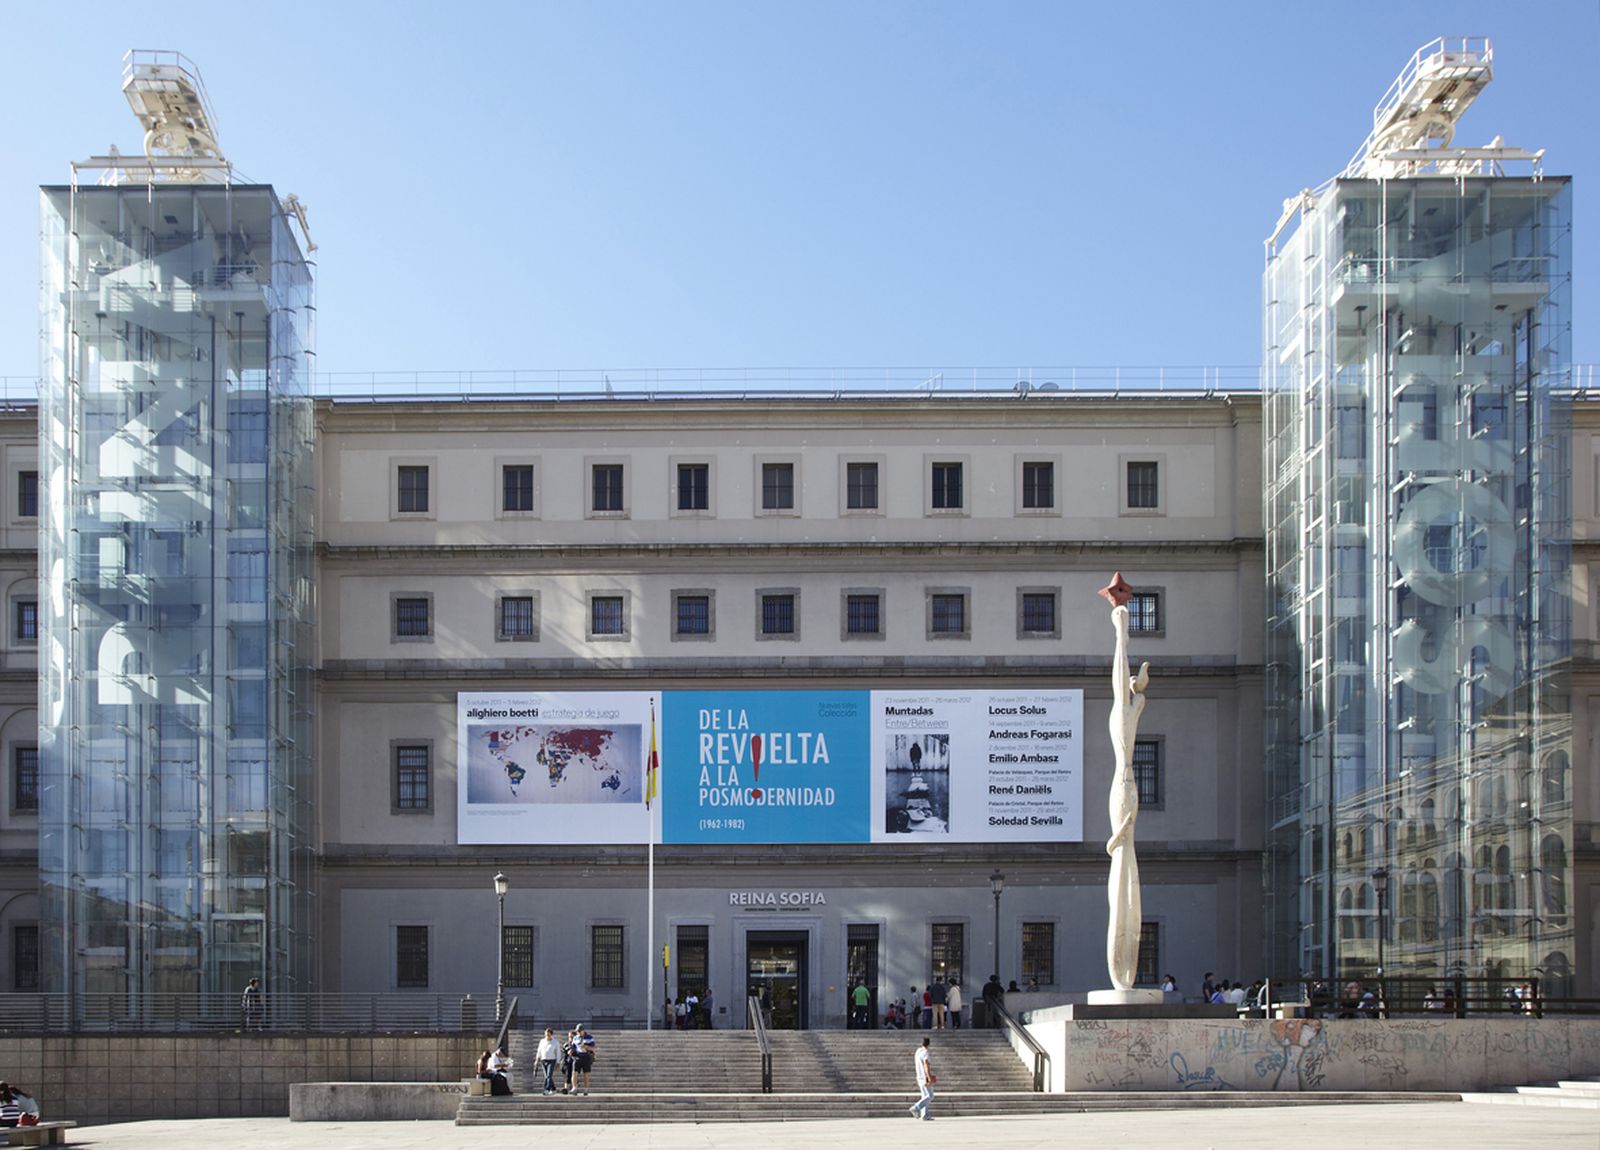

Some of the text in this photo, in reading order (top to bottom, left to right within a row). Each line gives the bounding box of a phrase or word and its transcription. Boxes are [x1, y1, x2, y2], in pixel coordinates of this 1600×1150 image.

[467, 708, 508, 719] alighiero
[510, 708, 538, 718] boetti
[585, 708, 596, 718] de
[596, 708, 620, 719] juego
[886, 706, 933, 716] Muntadas
[989, 705, 1046, 715] Locus Solus
[700, 709, 749, 730] DE LA
[989, 729, 1072, 741] Andreas Fogarasi
[700, 732, 830, 765] REVUELTA
[989, 753, 1059, 763] Emilio Ambasz
[699, 765, 739, 786] A LA
[989, 785, 1052, 794] René Daniëls
[700, 787, 835, 807] POSMODERNIDAD
[700, 819, 745, 831] (1962-1982)
[989, 816, 1063, 826] Soledad Sevilla
[730, 892, 826, 905] REINA SOFIA
